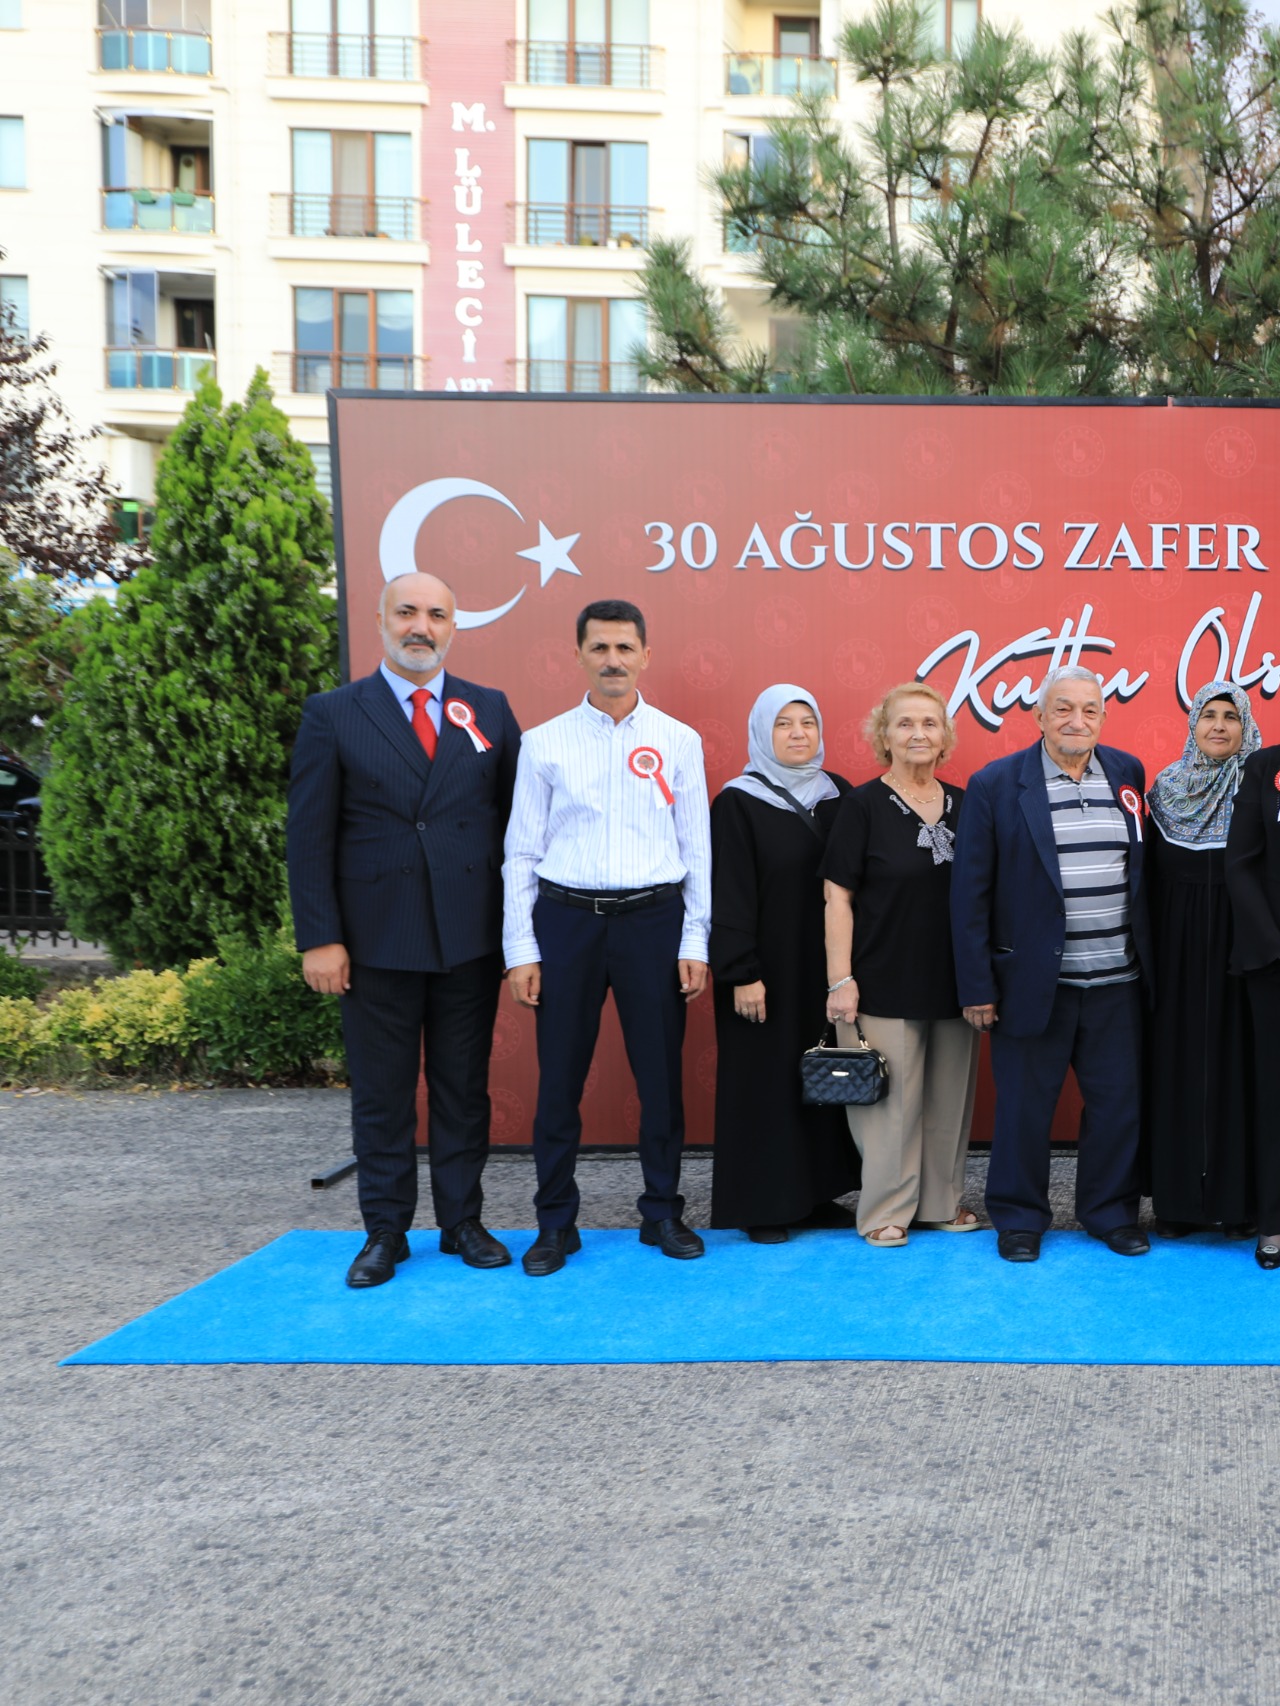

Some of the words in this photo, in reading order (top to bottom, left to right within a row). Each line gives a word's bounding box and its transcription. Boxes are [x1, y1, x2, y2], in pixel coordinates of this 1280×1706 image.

[450, 101, 497, 133] M.
[644, 521, 718, 572] 30
[734, 510, 1045, 571] AĞUSTOS
[1063, 522, 1269, 571] ZAFER
